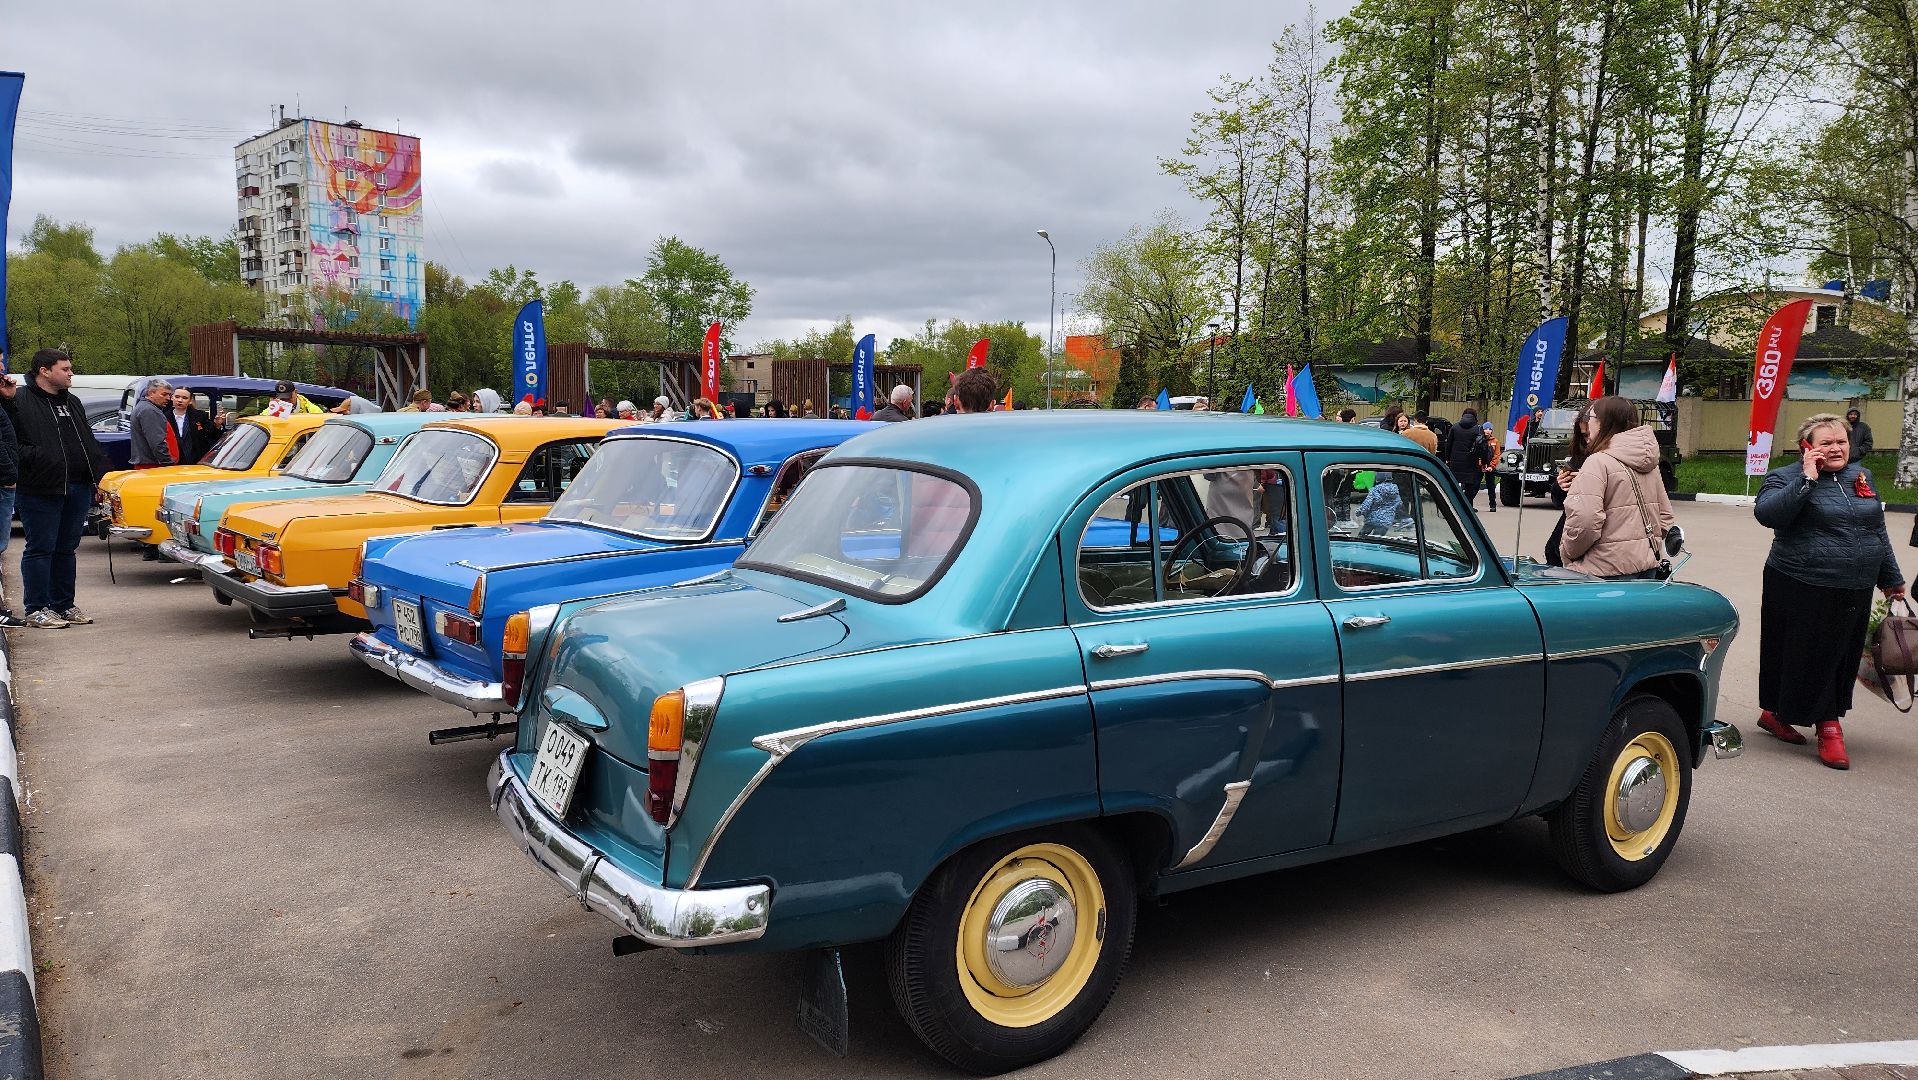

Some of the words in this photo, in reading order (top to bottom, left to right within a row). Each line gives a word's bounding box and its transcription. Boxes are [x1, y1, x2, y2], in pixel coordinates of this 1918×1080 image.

[555, 735, 576, 768] 049
[535, 760, 552, 794] ТК
[552, 773, 568, 800] 199
